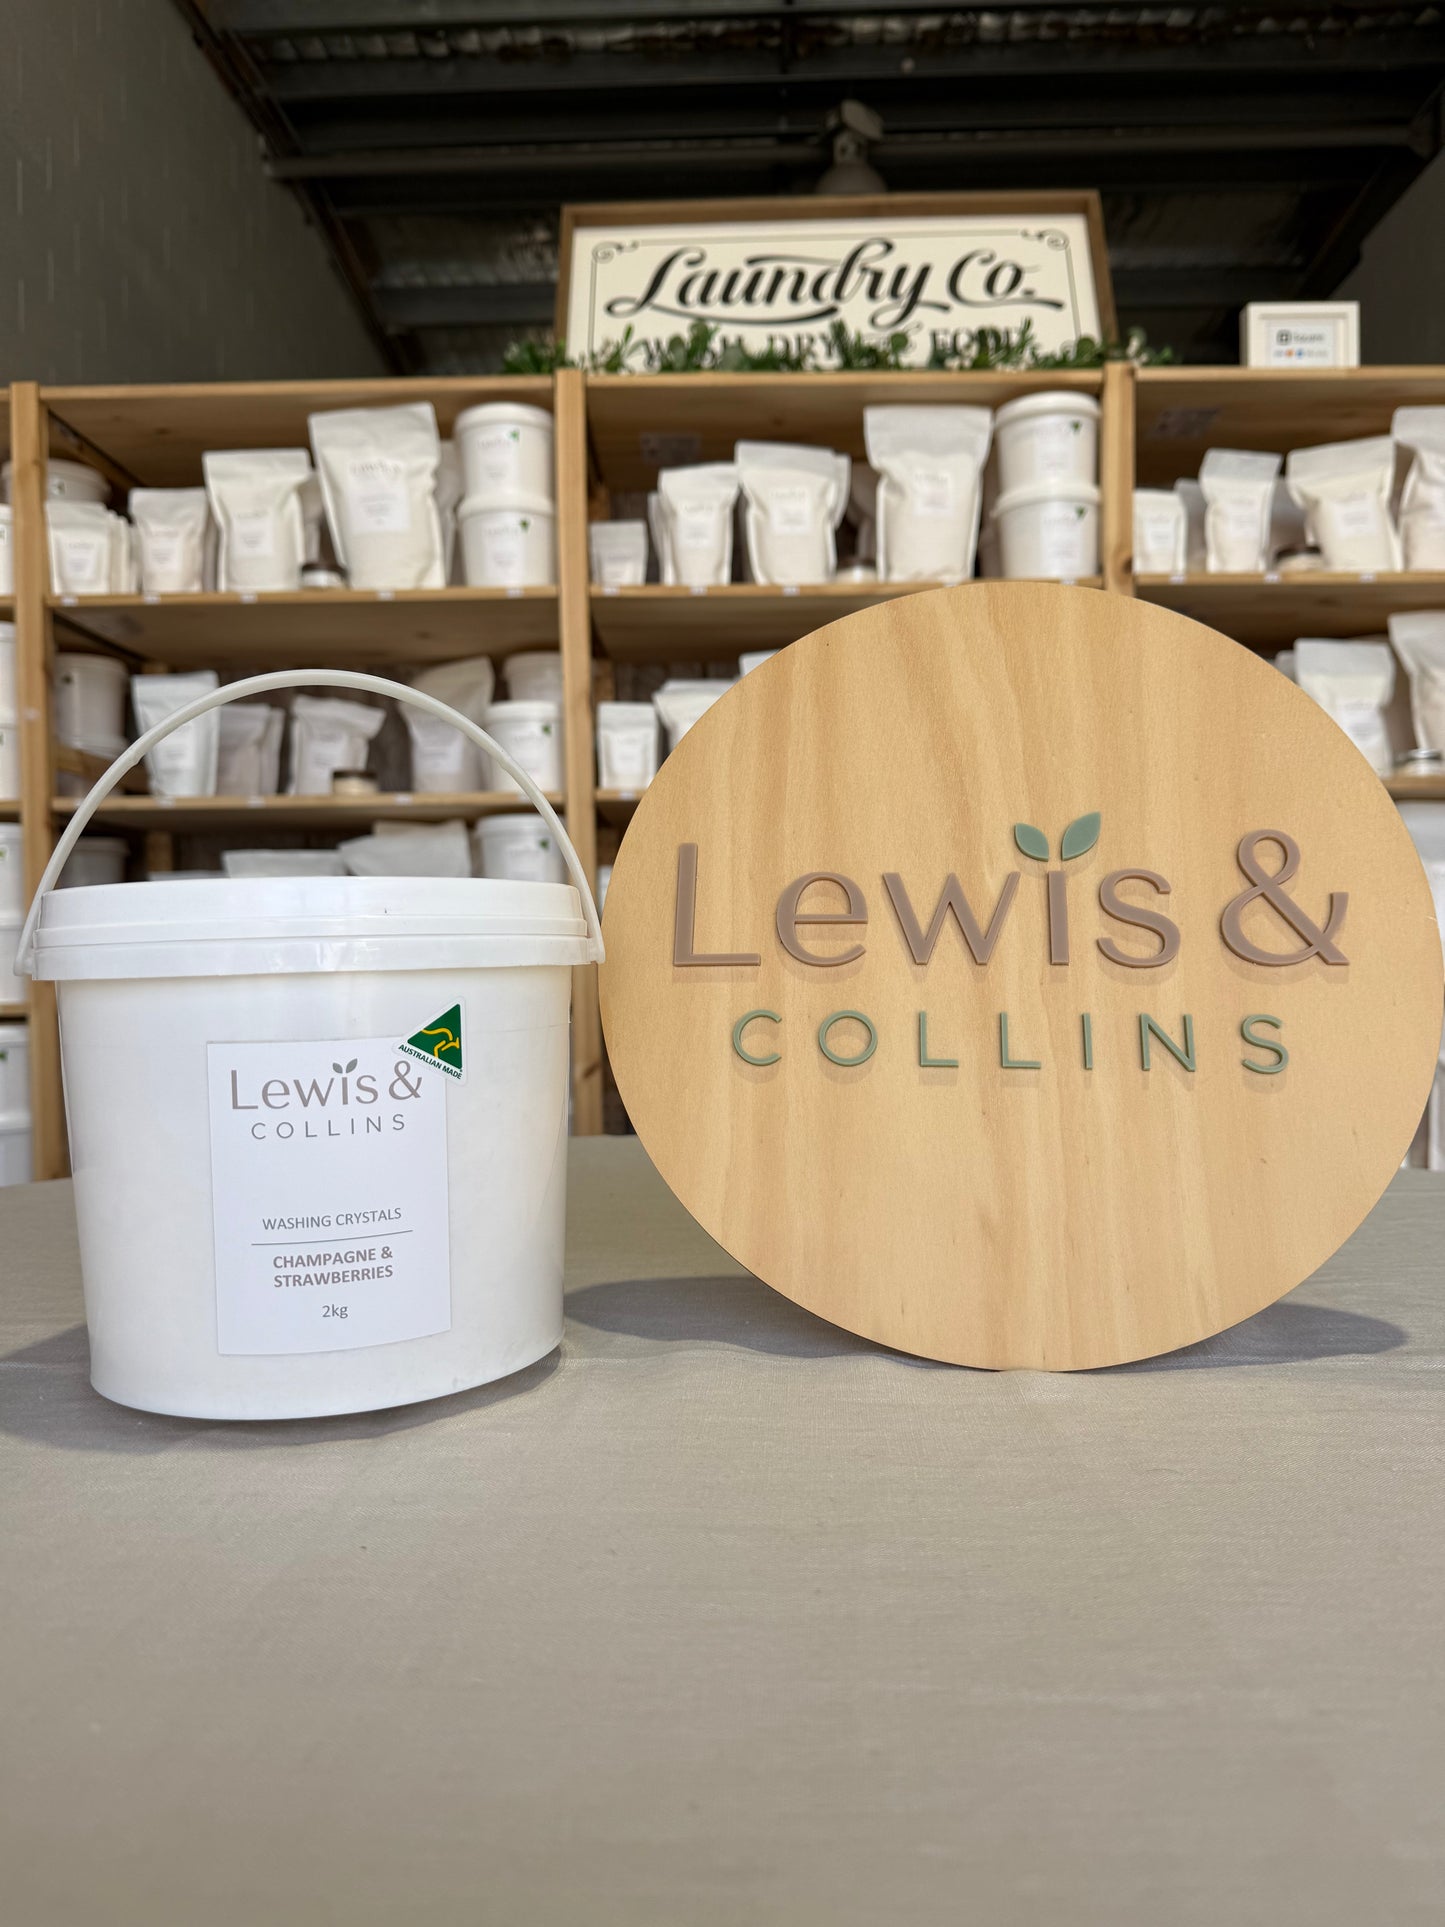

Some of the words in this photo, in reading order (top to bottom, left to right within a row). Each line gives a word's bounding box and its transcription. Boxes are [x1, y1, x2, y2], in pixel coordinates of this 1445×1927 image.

[604, 237, 950, 328] Laundry
[947, 249, 1064, 308] Co.
[673, 842, 1182, 968] Lewis
[1220, 829, 1350, 968] &
[732, 1010, 1290, 1074] COLLINS
[398, 1044, 442, 1069] AUSTRALIAN
[442, 1065, 463, 1079] MADE
[231, 1070, 379, 1110] Lewis
[388, 1060, 422, 1100] &
[251, 1113, 405, 1140] COLLINS
[262, 1214, 332, 1231] WASHING
[335, 1207, 402, 1226] CRYSTALS
[273, 1248, 377, 1269] CHAMPAGNE
[381, 1246, 393, 1259] &
[273, 1264, 394, 1288] STRAWBERRIES
[322, 1303, 349, 1319] 2kg
